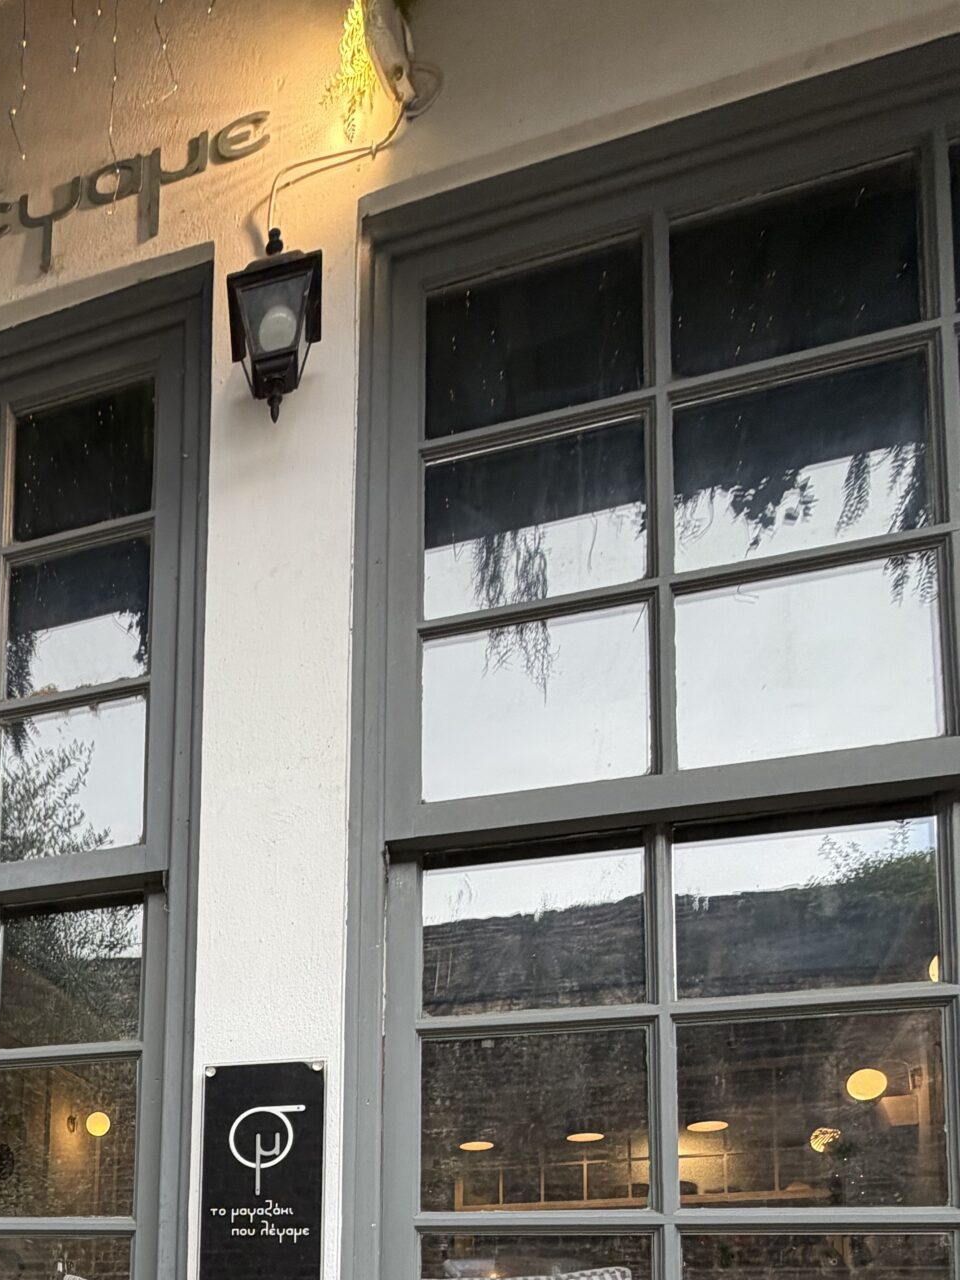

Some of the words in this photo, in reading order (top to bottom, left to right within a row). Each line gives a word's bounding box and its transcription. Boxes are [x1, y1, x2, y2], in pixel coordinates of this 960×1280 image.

[210, 1207, 227, 1216] το
[231, 1200, 294, 1223] μαγαζάκι
[231, 1226, 256, 1237] που
[260, 1220, 310, 1243] λέγαμε
